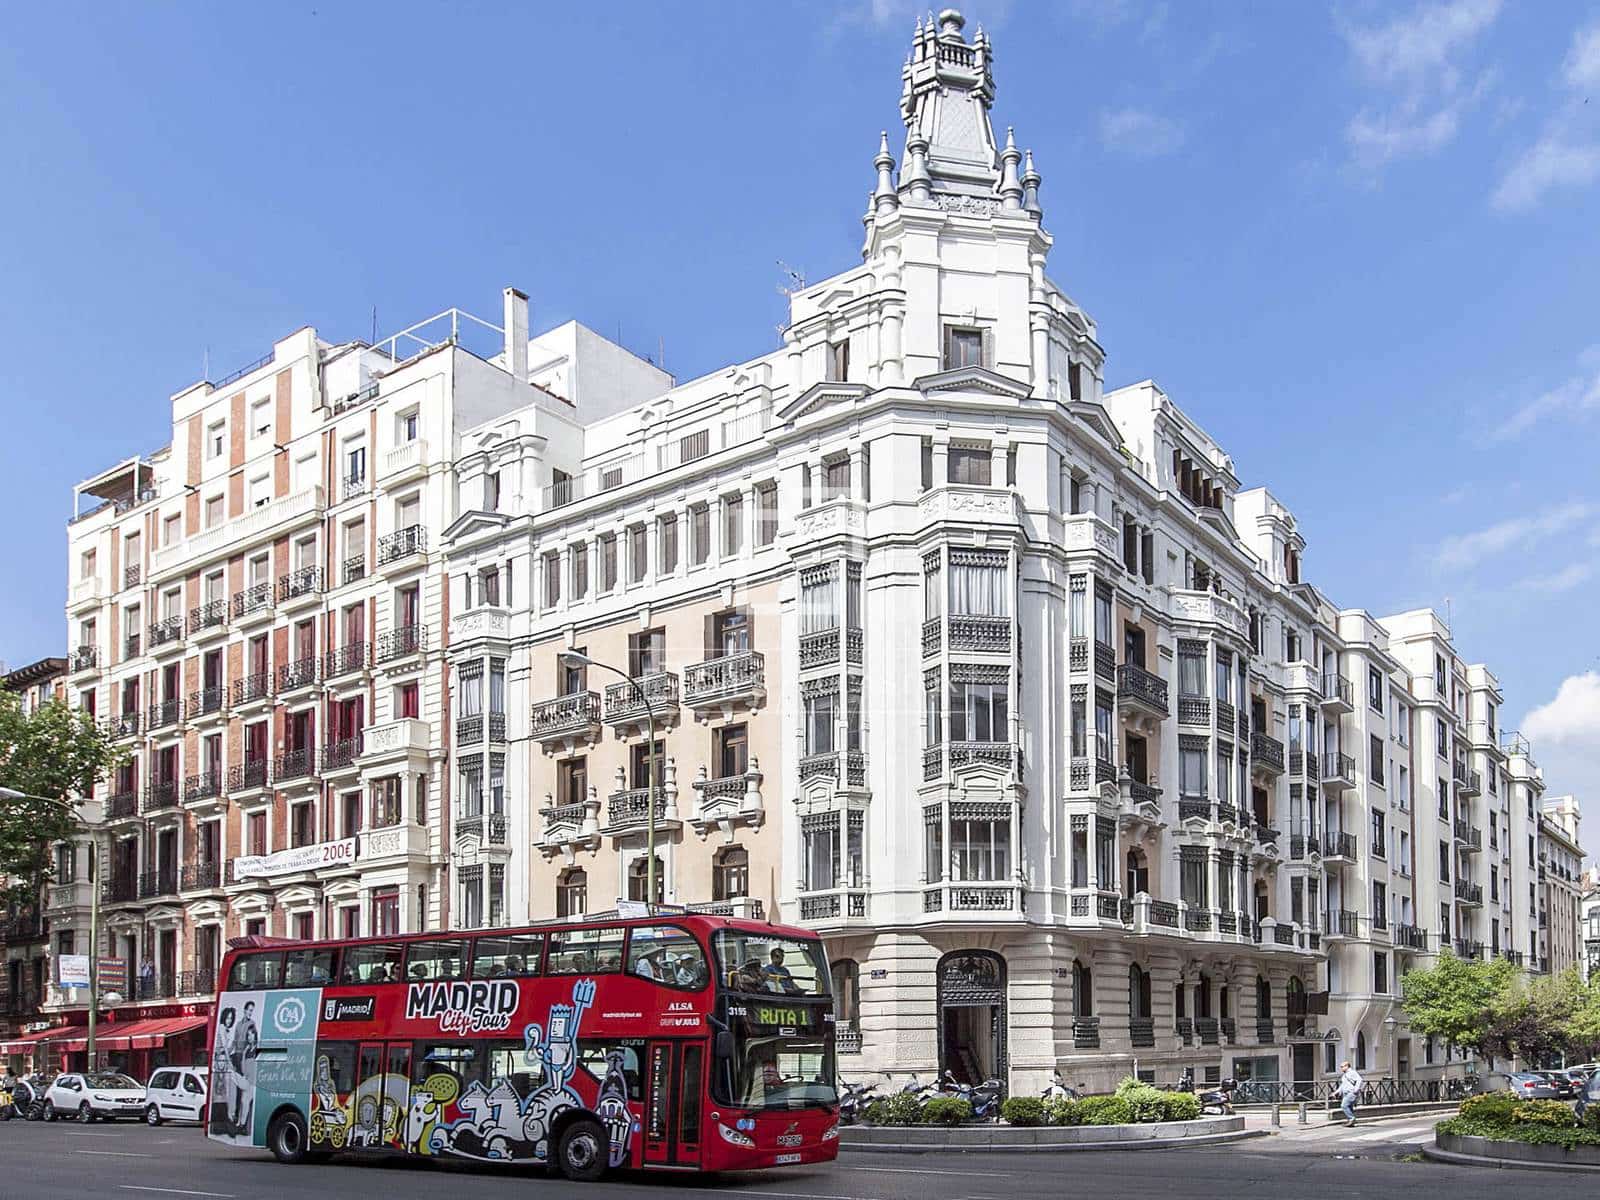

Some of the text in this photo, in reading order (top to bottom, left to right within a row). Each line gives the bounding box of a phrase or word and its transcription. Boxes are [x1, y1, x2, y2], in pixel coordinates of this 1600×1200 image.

[323, 842, 353, 862] 200€
[406, 980, 520, 1019] MADRID
[668, 1002, 693, 1011] ALSA
[279, 1007, 299, 1023] C&A
[441, 1007, 511, 1036] City Tour
[760, 1008, 808, 1025] RUTA 1
